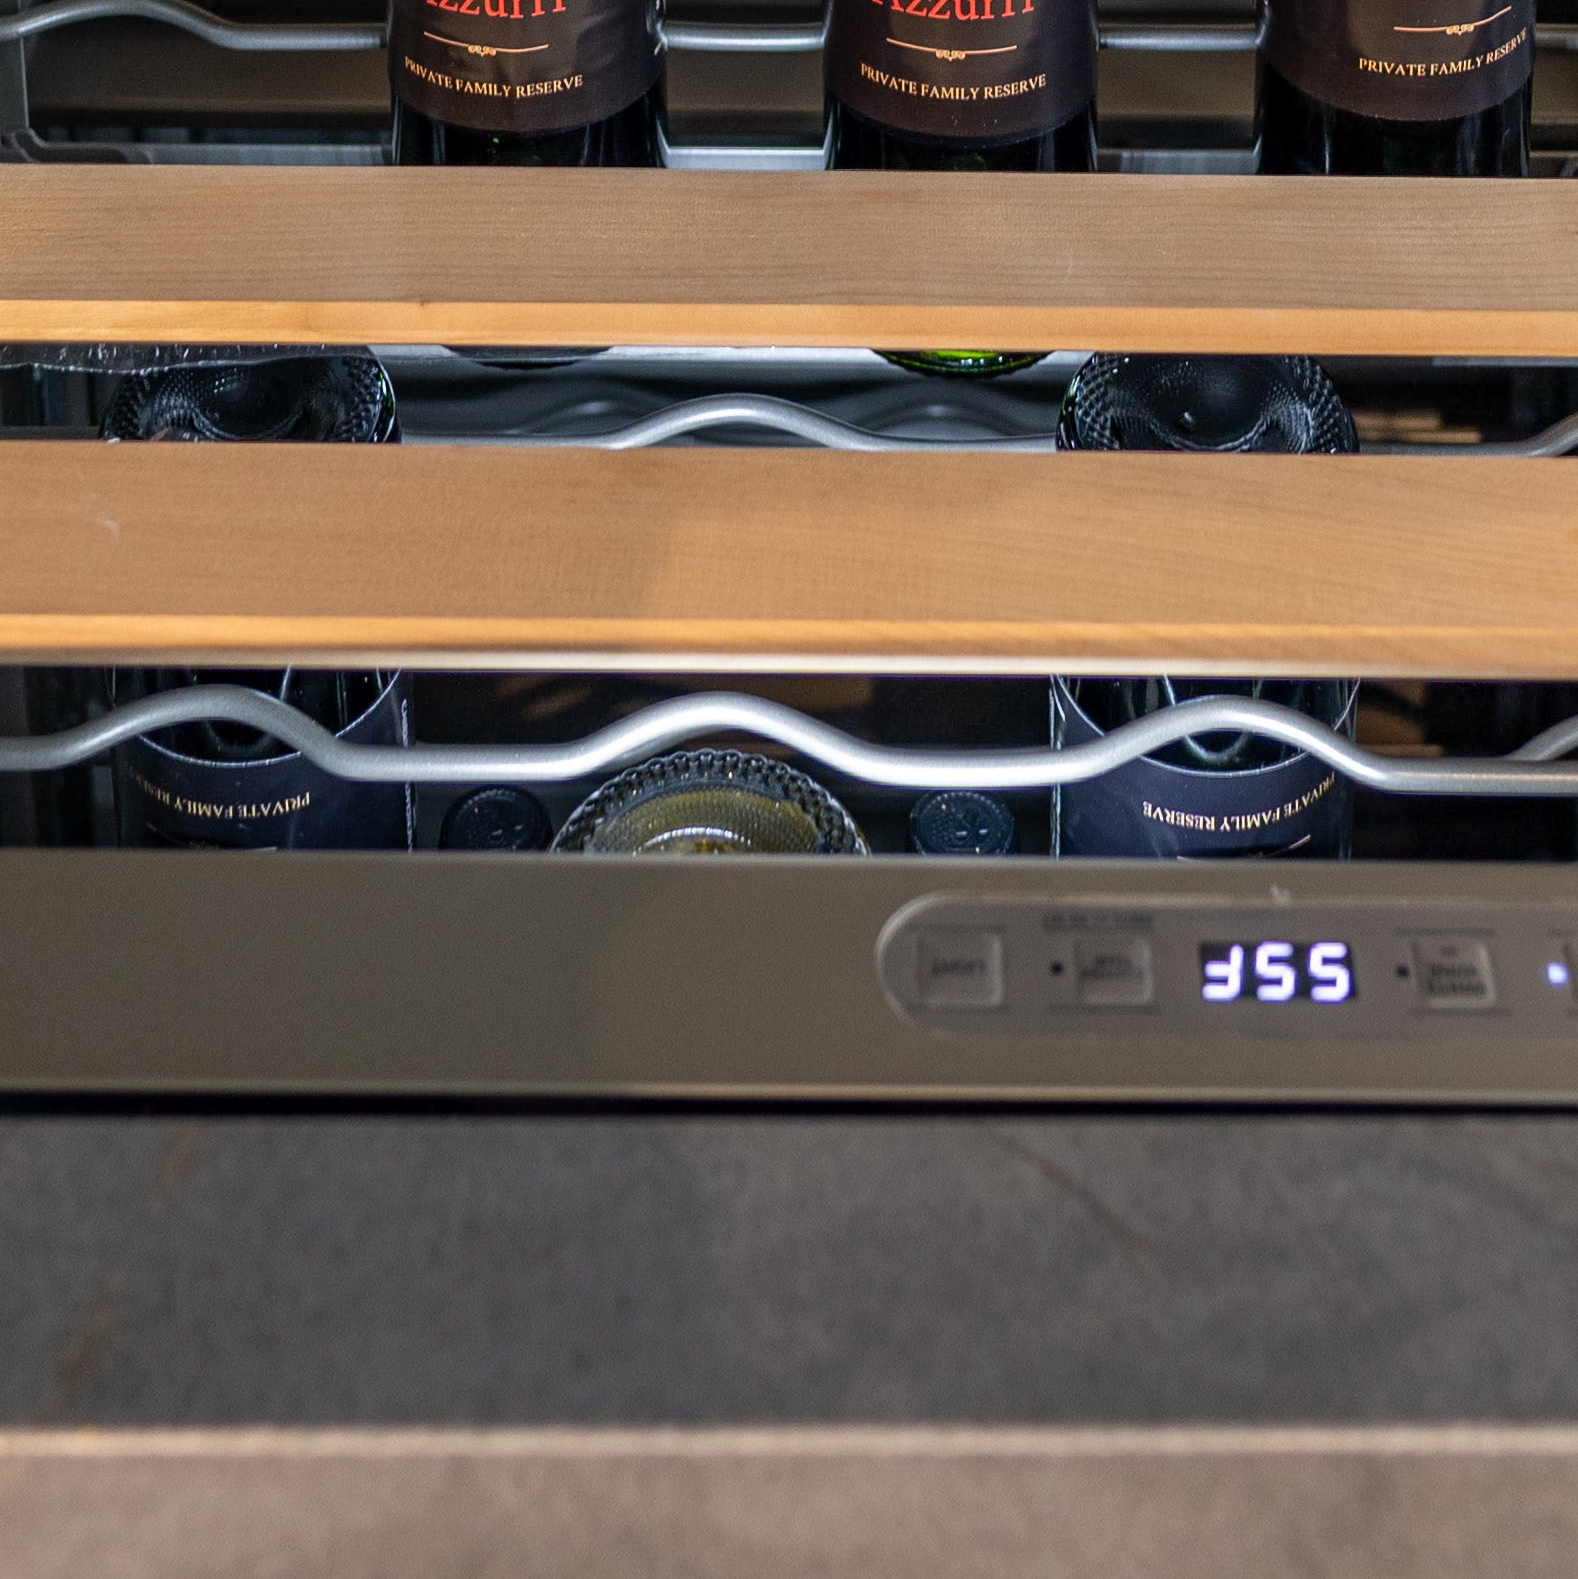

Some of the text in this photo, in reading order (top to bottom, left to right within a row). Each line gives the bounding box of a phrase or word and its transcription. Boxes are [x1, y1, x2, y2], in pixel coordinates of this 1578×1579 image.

[1358, 26, 1527, 77] PRIVATE FAMILY RESERVE
[404, 56, 583, 99] PRIVATE FAMILY RESERVE
[860, 63, 1047, 101] PRIVATE FAMILY RESERVE
[173, 796, 233, 819] FAMILY
[238, 791, 310, 819] PRIVATE
[1142, 771, 1335, 832] PRIVATE FAMILY RESERVE
